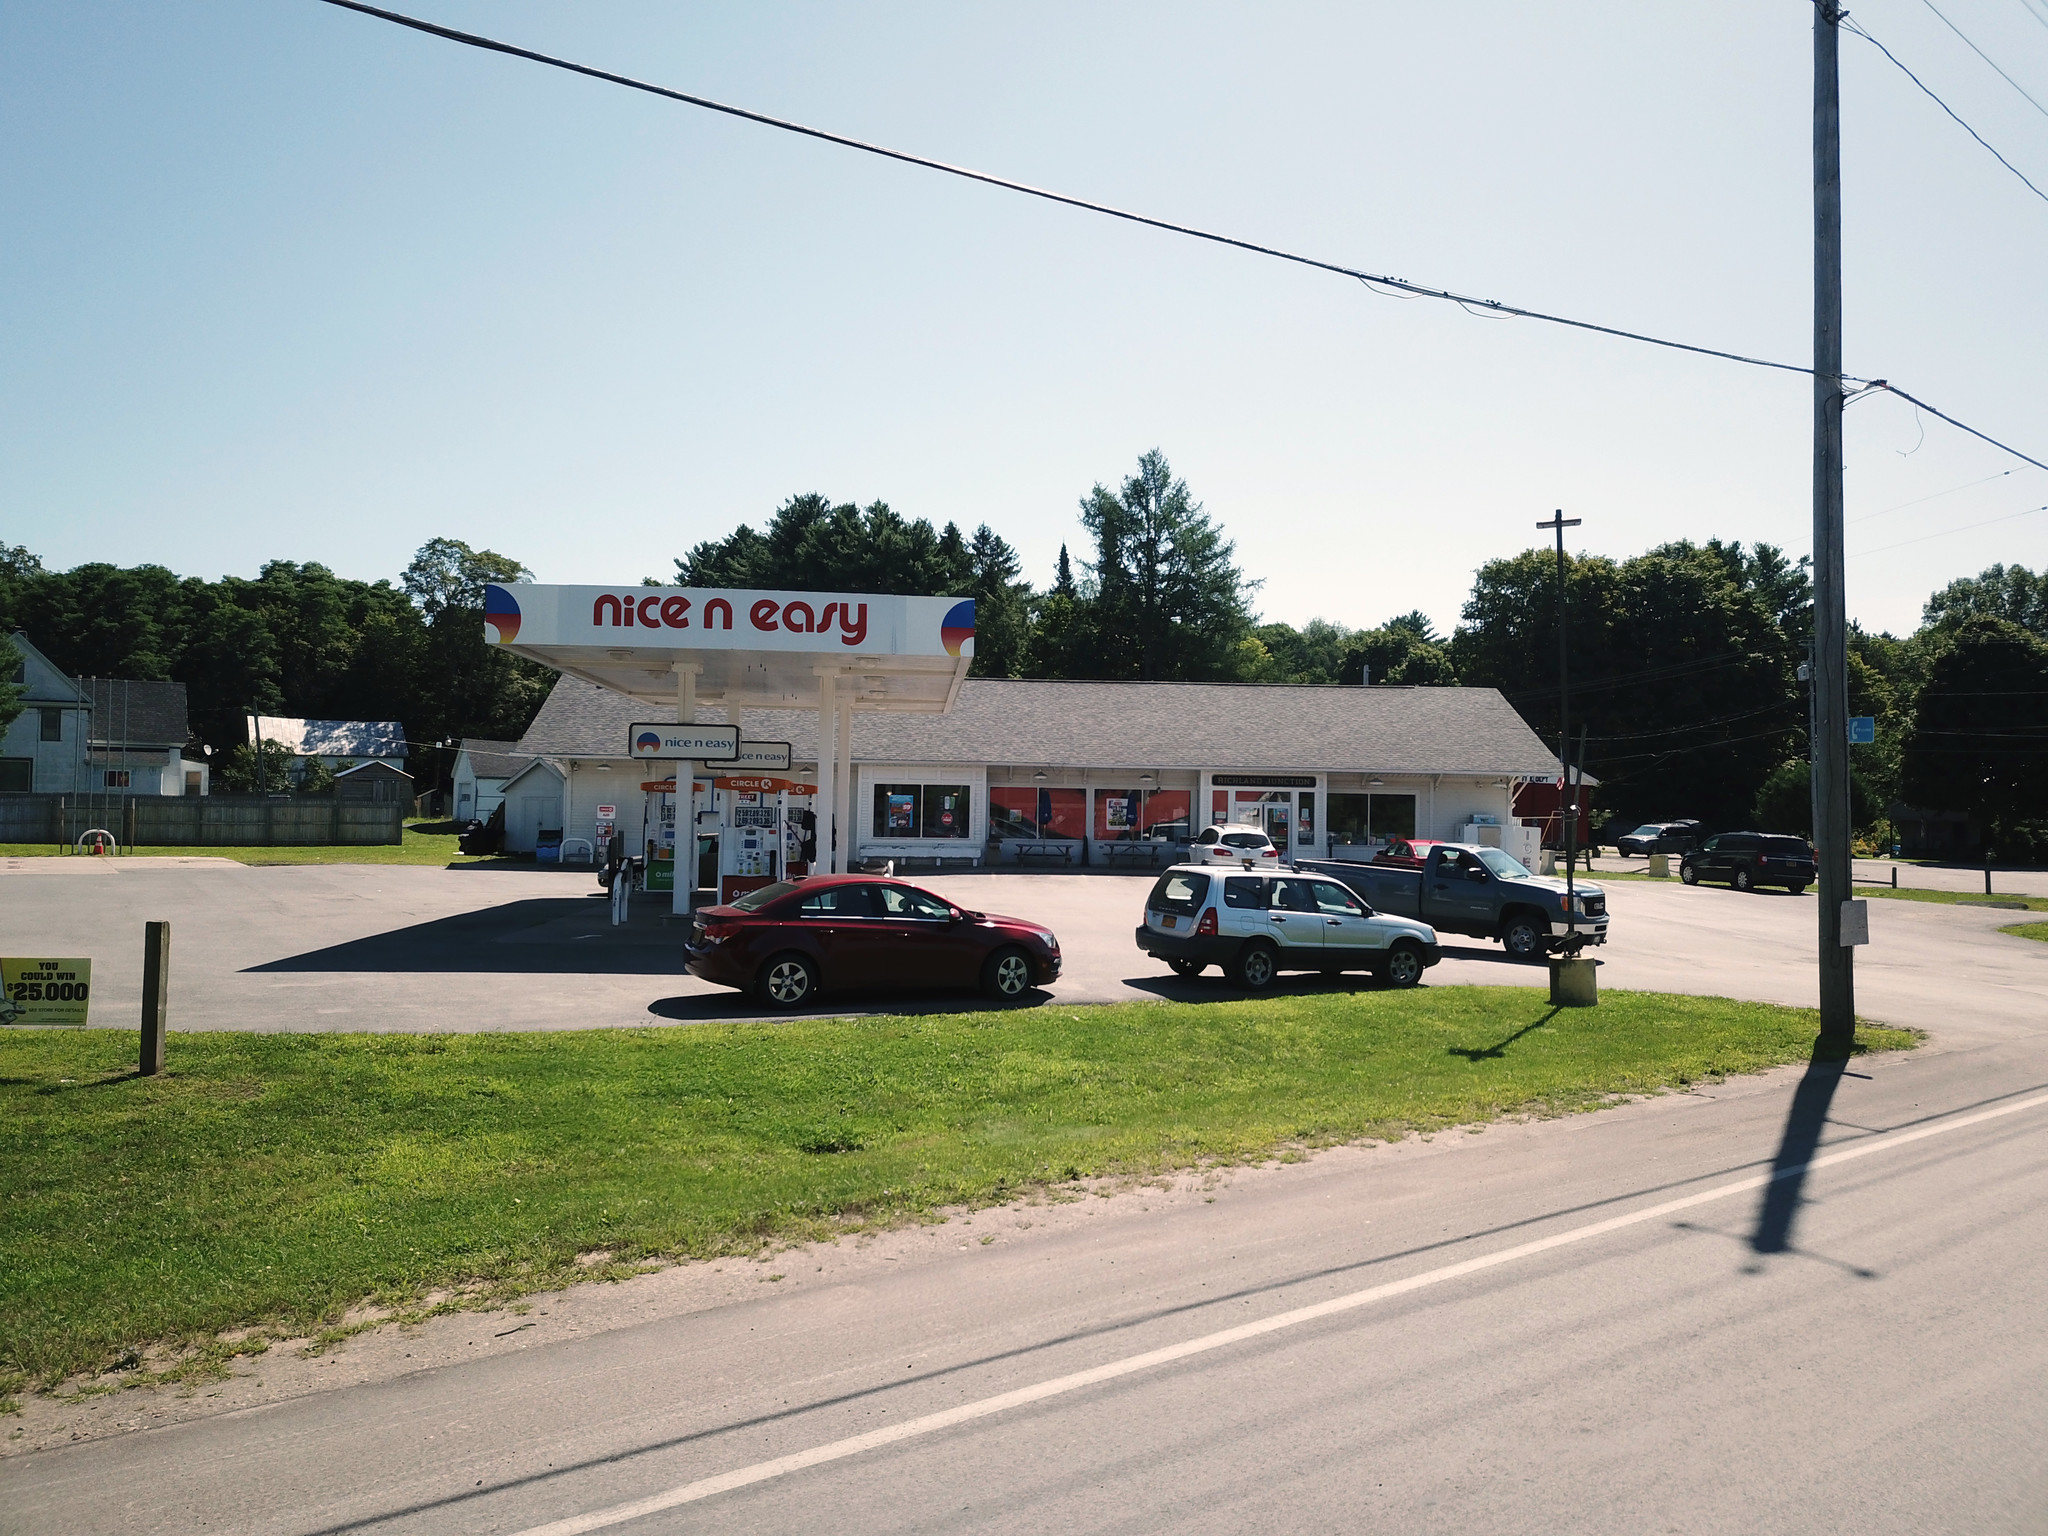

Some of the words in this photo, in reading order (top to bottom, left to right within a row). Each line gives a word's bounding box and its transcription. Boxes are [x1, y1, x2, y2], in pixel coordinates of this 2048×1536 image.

[593, 594, 690, 629] nice
[703, 598, 734, 630] n
[749, 599, 869, 647] easy
[665, 737, 691, 748] nice
[694, 739, 703, 748] n
[705, 739, 735, 751] easy
[764, 753, 788, 763] easy
[761, 779, 772, 789] K
[1217, 776, 1263, 784] RICHLAND
[1267, 777, 1311, 785] JUNCTION
[39, 962, 58, 971] YOU
[21, 972, 53, 981] COULD
[56, 972, 76, 981] WIN
